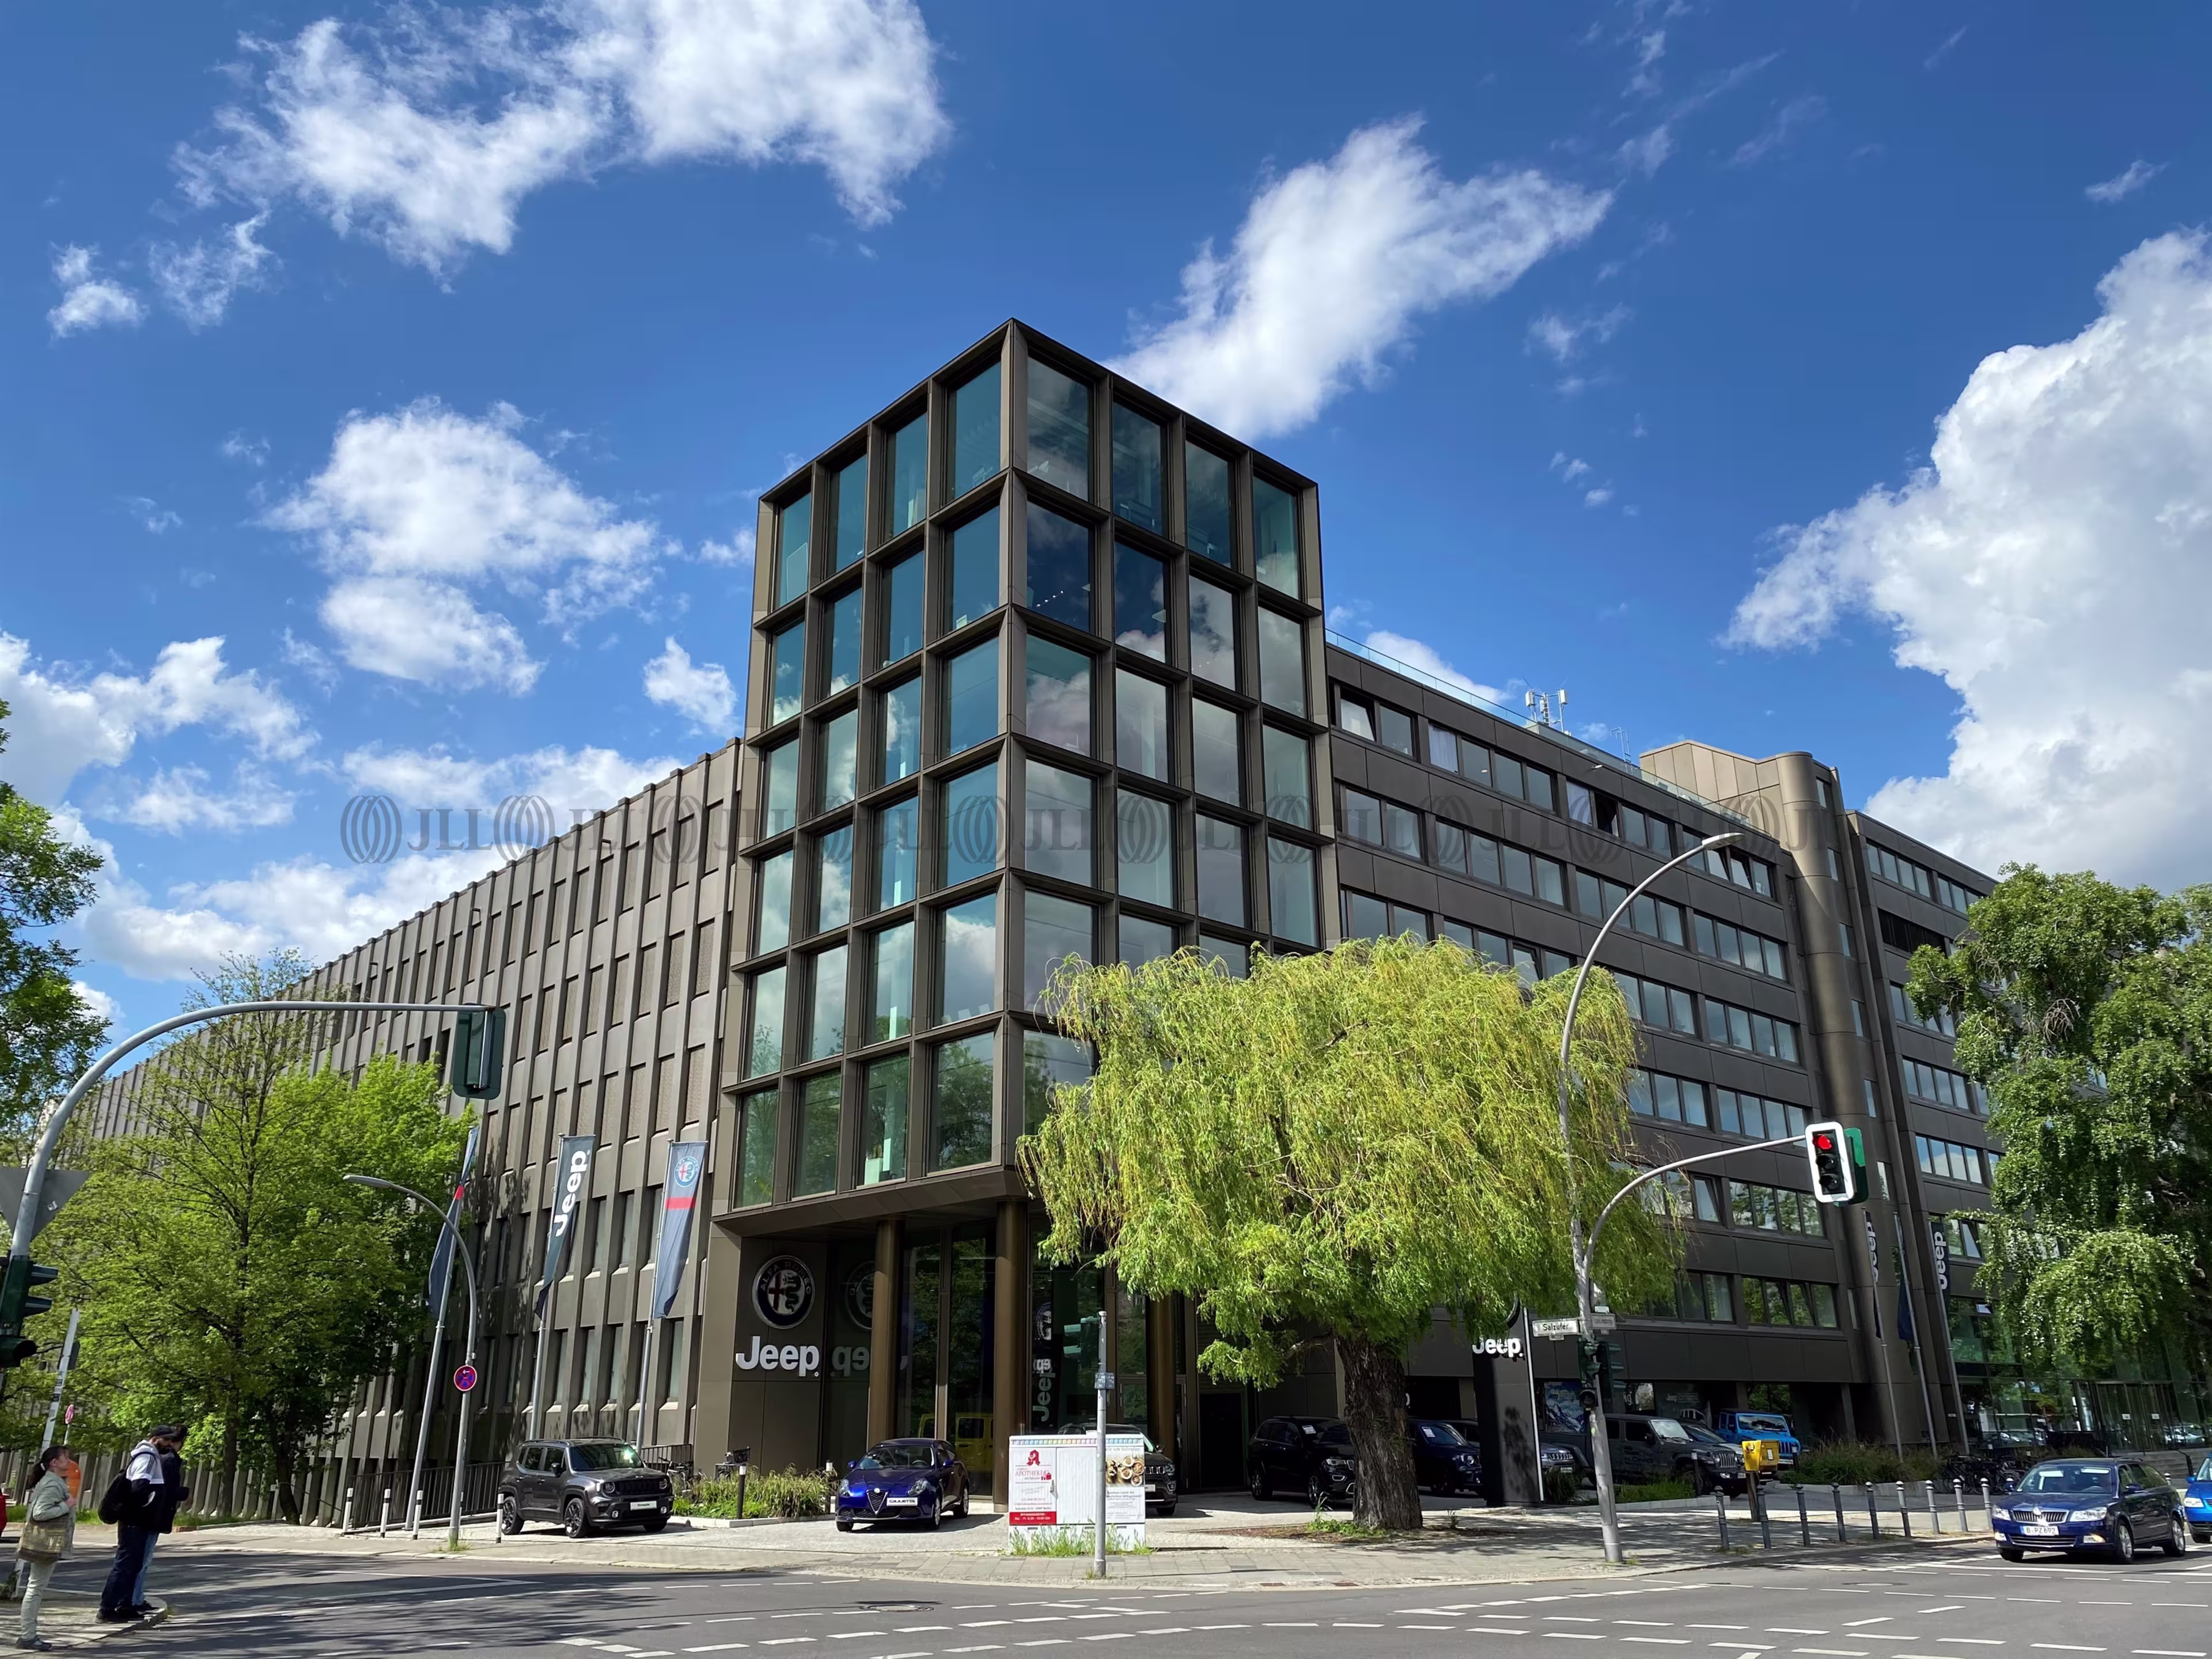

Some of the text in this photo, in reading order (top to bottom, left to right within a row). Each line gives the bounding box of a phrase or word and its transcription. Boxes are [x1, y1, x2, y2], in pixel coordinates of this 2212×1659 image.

[554, 1150, 588, 1237] Jeep
[760, 1264, 781, 1291] ALFA
[784, 1261, 812, 1294] ROMEO
[1543, 1323, 1569, 1331] Salzufer
[736, 1336, 820, 1377] Jeep
[1472, 1336, 1522, 1358] Jeep
